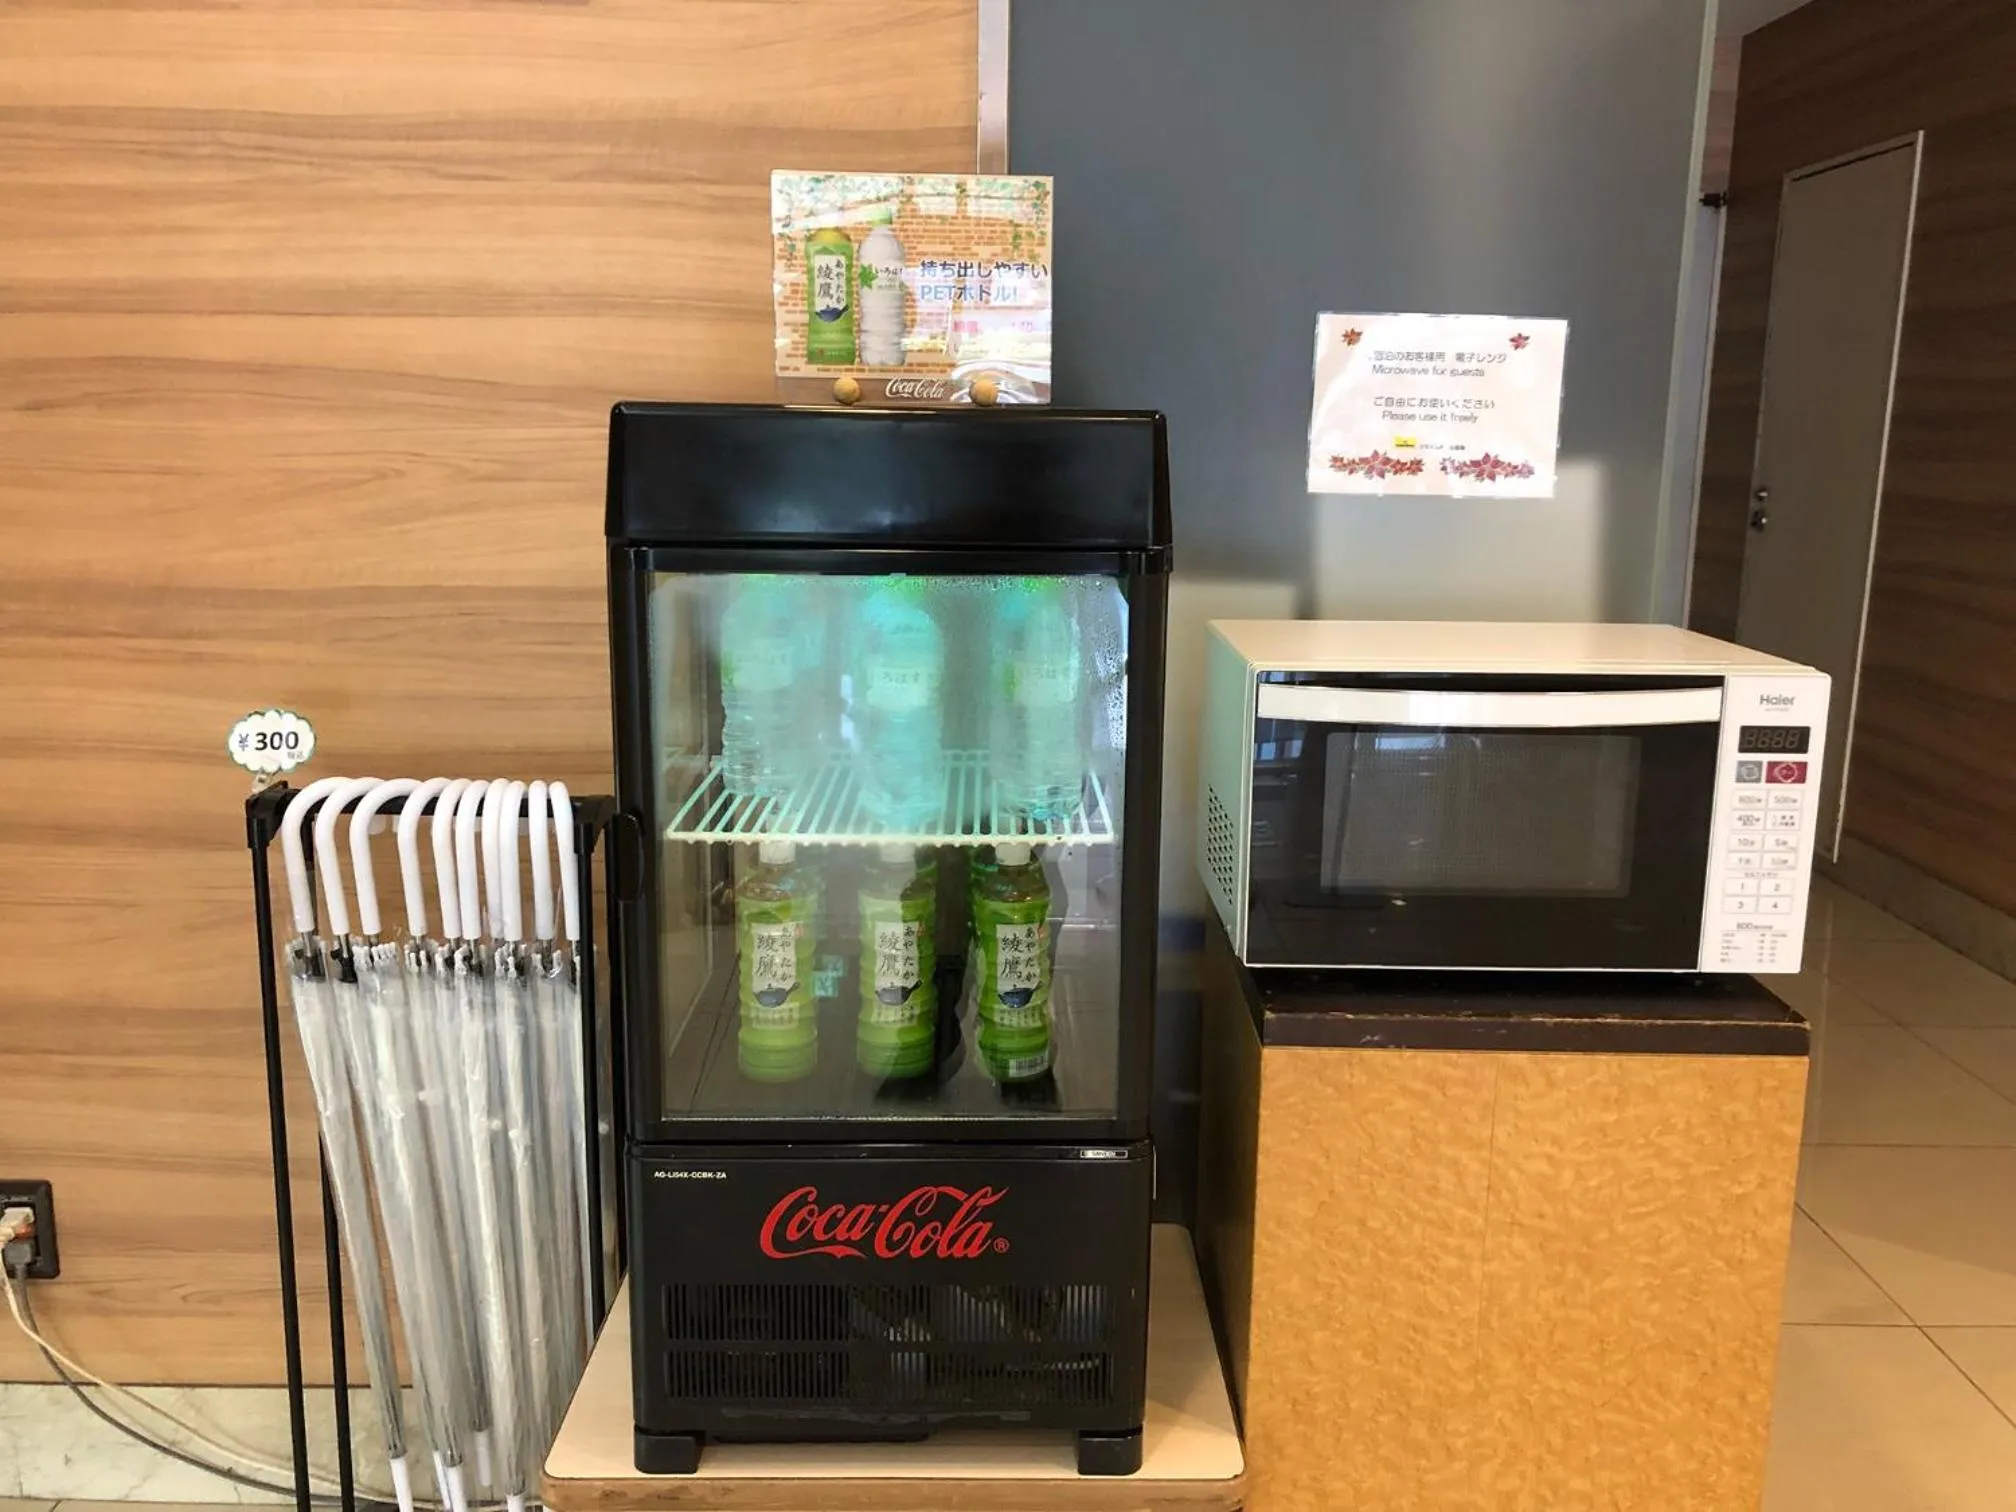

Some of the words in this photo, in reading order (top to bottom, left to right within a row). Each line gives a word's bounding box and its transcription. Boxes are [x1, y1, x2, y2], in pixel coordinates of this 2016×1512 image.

[919, 259, 1049, 279] 持ち出しやすい
[1371, 363, 1430, 375] Microwave
[1431, 364, 1448, 376] for
[1449, 367, 1486, 378] guests
[1372, 396, 1496, 410] ご自由にお使いください
[1382, 409, 1417, 421] Please
[1418, 412, 1438, 422] use
[1440, 411, 1448, 422] it
[1450, 412, 1479, 424] freely
[1759, 693, 1796, 706] Haier
[759, 1185, 1010, 1260] Coca-Cola
